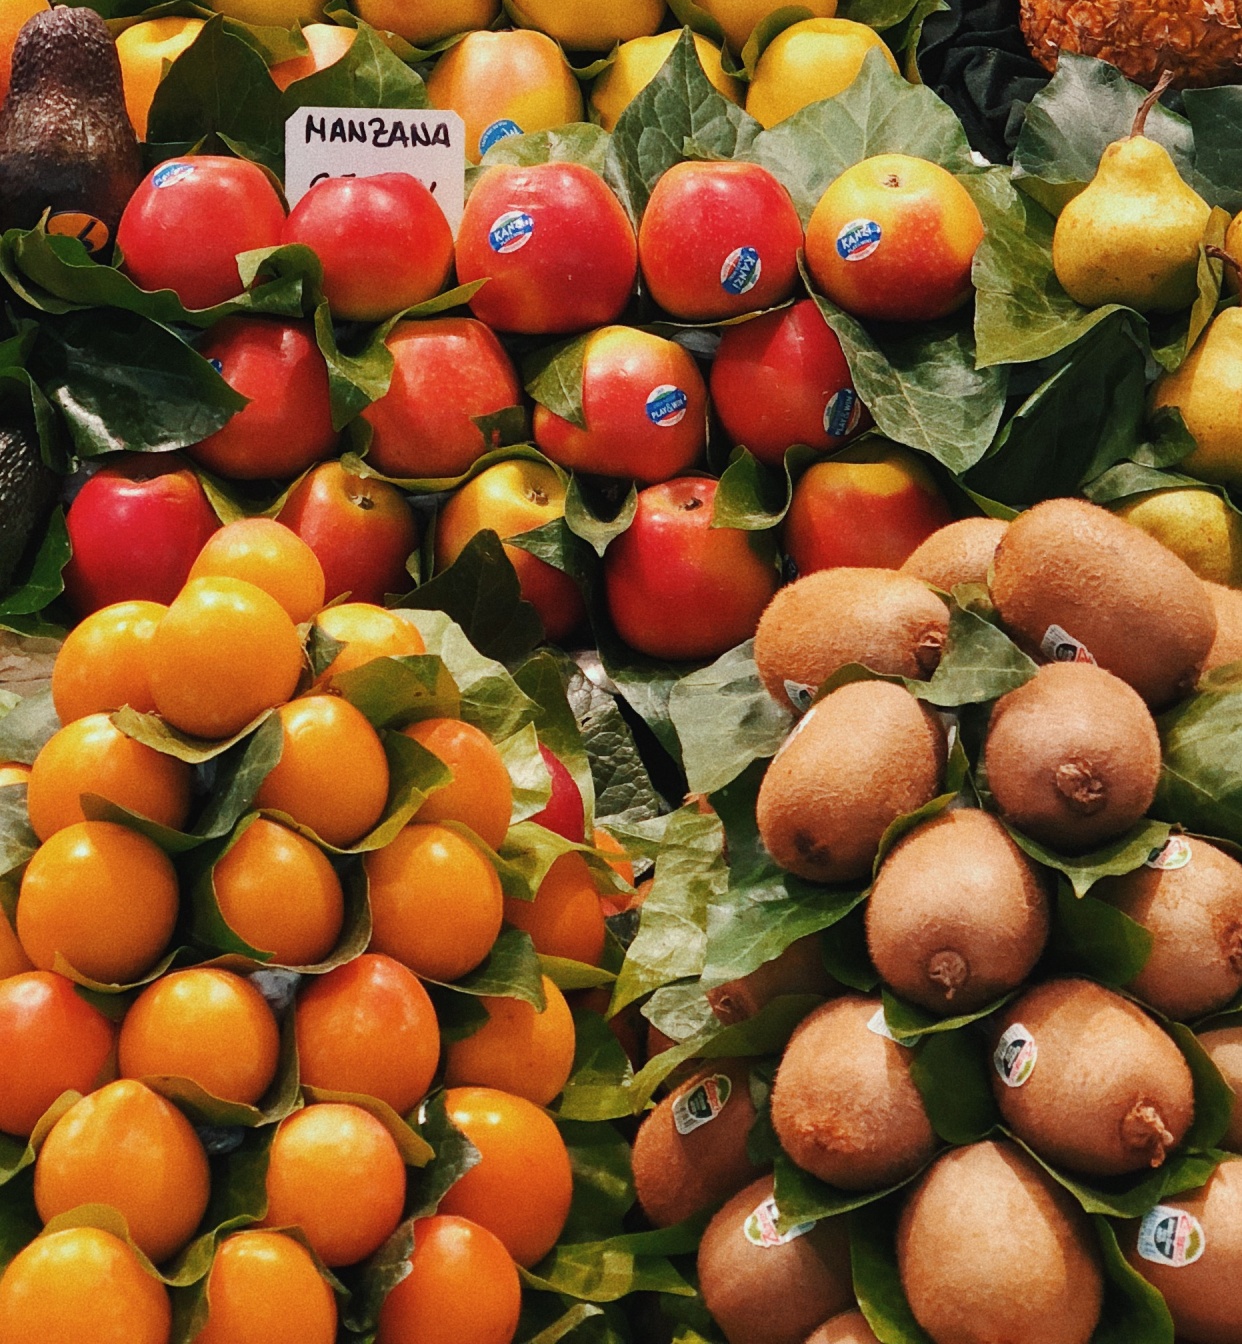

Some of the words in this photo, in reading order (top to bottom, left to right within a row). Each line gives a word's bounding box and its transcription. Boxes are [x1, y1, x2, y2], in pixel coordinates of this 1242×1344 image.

[305, 114, 451, 148] MANZANA
[841, 223, 872, 249] KANZI
[732, 256, 755, 289] KANZI
